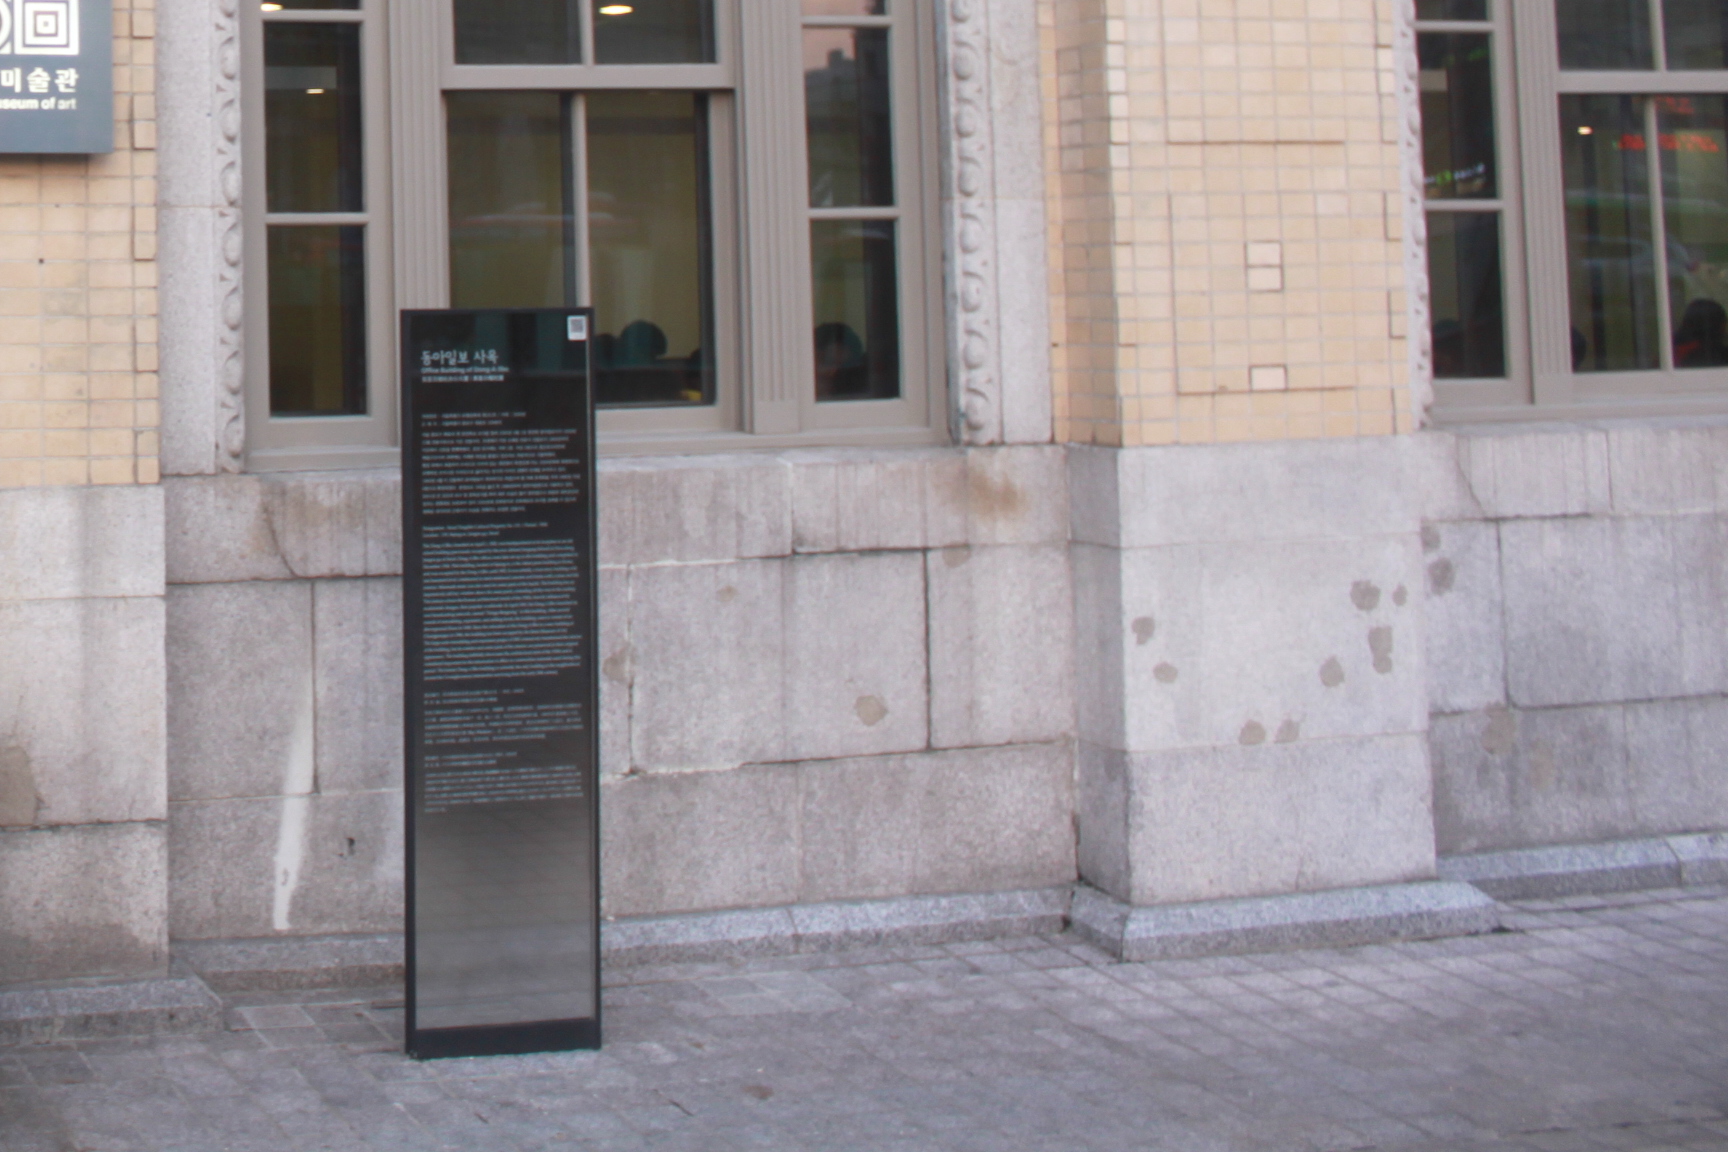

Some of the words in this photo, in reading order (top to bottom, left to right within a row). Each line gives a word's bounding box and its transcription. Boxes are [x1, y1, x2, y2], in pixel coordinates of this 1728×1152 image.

[41, 96, 56, 109] of
[57, 98, 77, 110] art
[420, 350, 469, 366] 동아일보
[473, 349, 499, 364] 사옥
